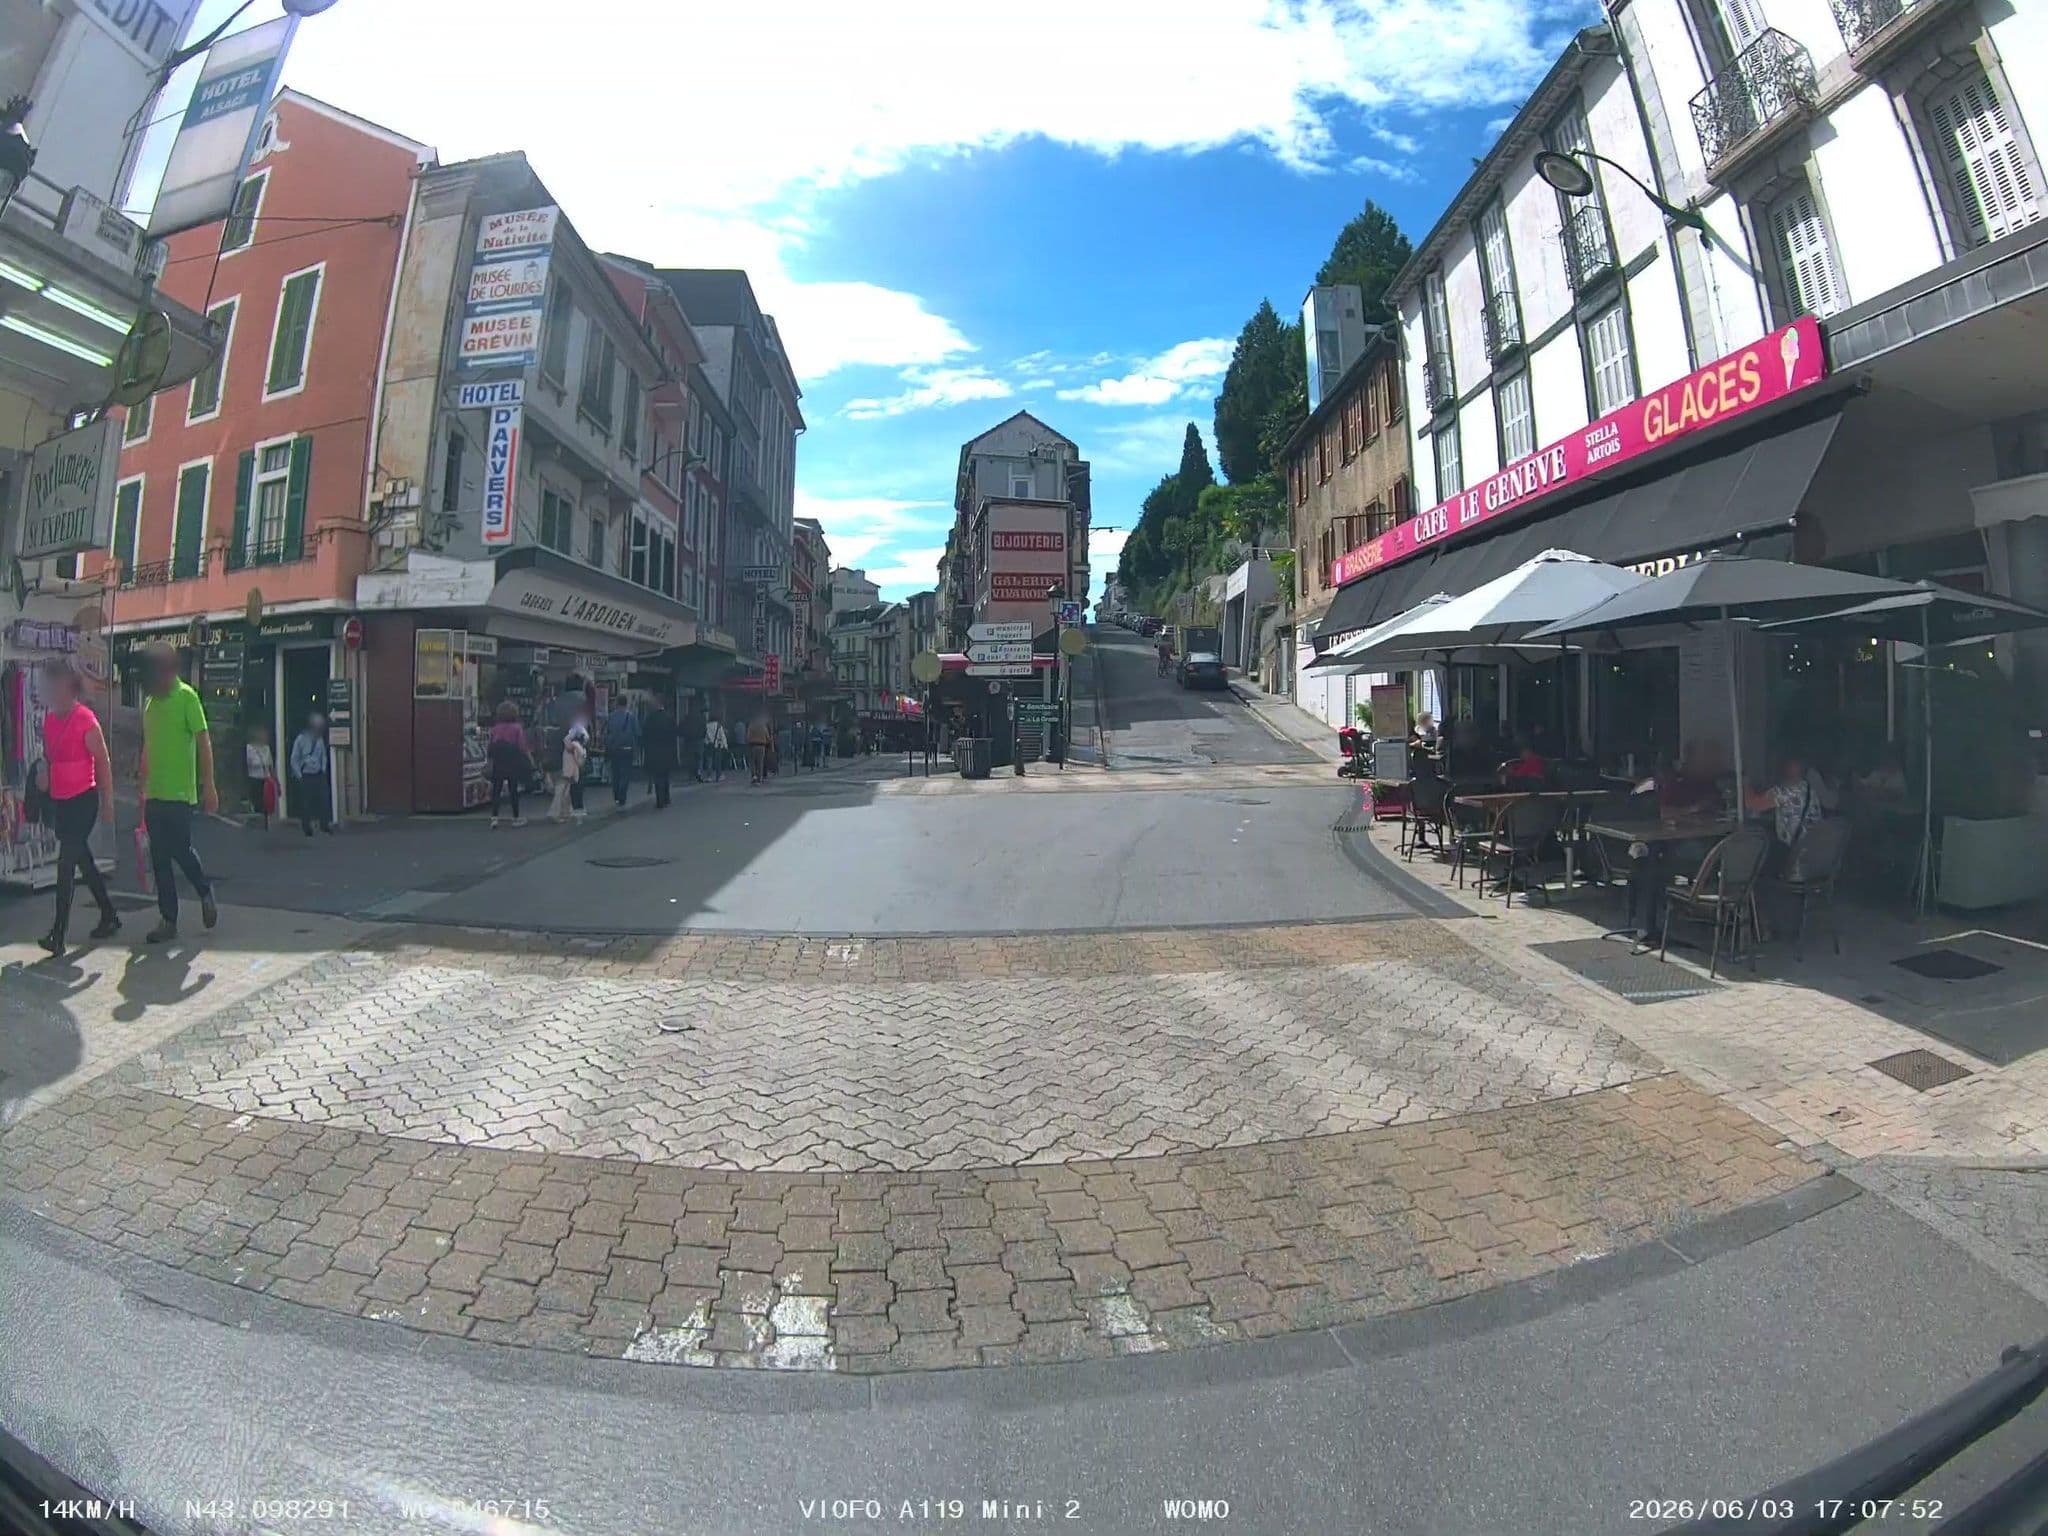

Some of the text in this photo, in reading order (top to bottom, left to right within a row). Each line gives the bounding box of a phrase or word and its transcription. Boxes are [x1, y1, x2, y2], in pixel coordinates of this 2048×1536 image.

[201, 69, 261, 103] HOTEL
[471, 280, 543, 300] DE LOURDES
[462, 383, 521, 404] HOTEL
[1643, 351, 1762, 443] GLACES
[1584, 422, 1619, 448] STELLA
[1586, 439, 1621, 465] ARTOIS
[486, 408, 519, 526] D'ANVERS
[1344, 445, 1567, 576] BRASSERIE CAFE LE GENEVE
[993, 534, 1062, 548] BIJOUTERIE
